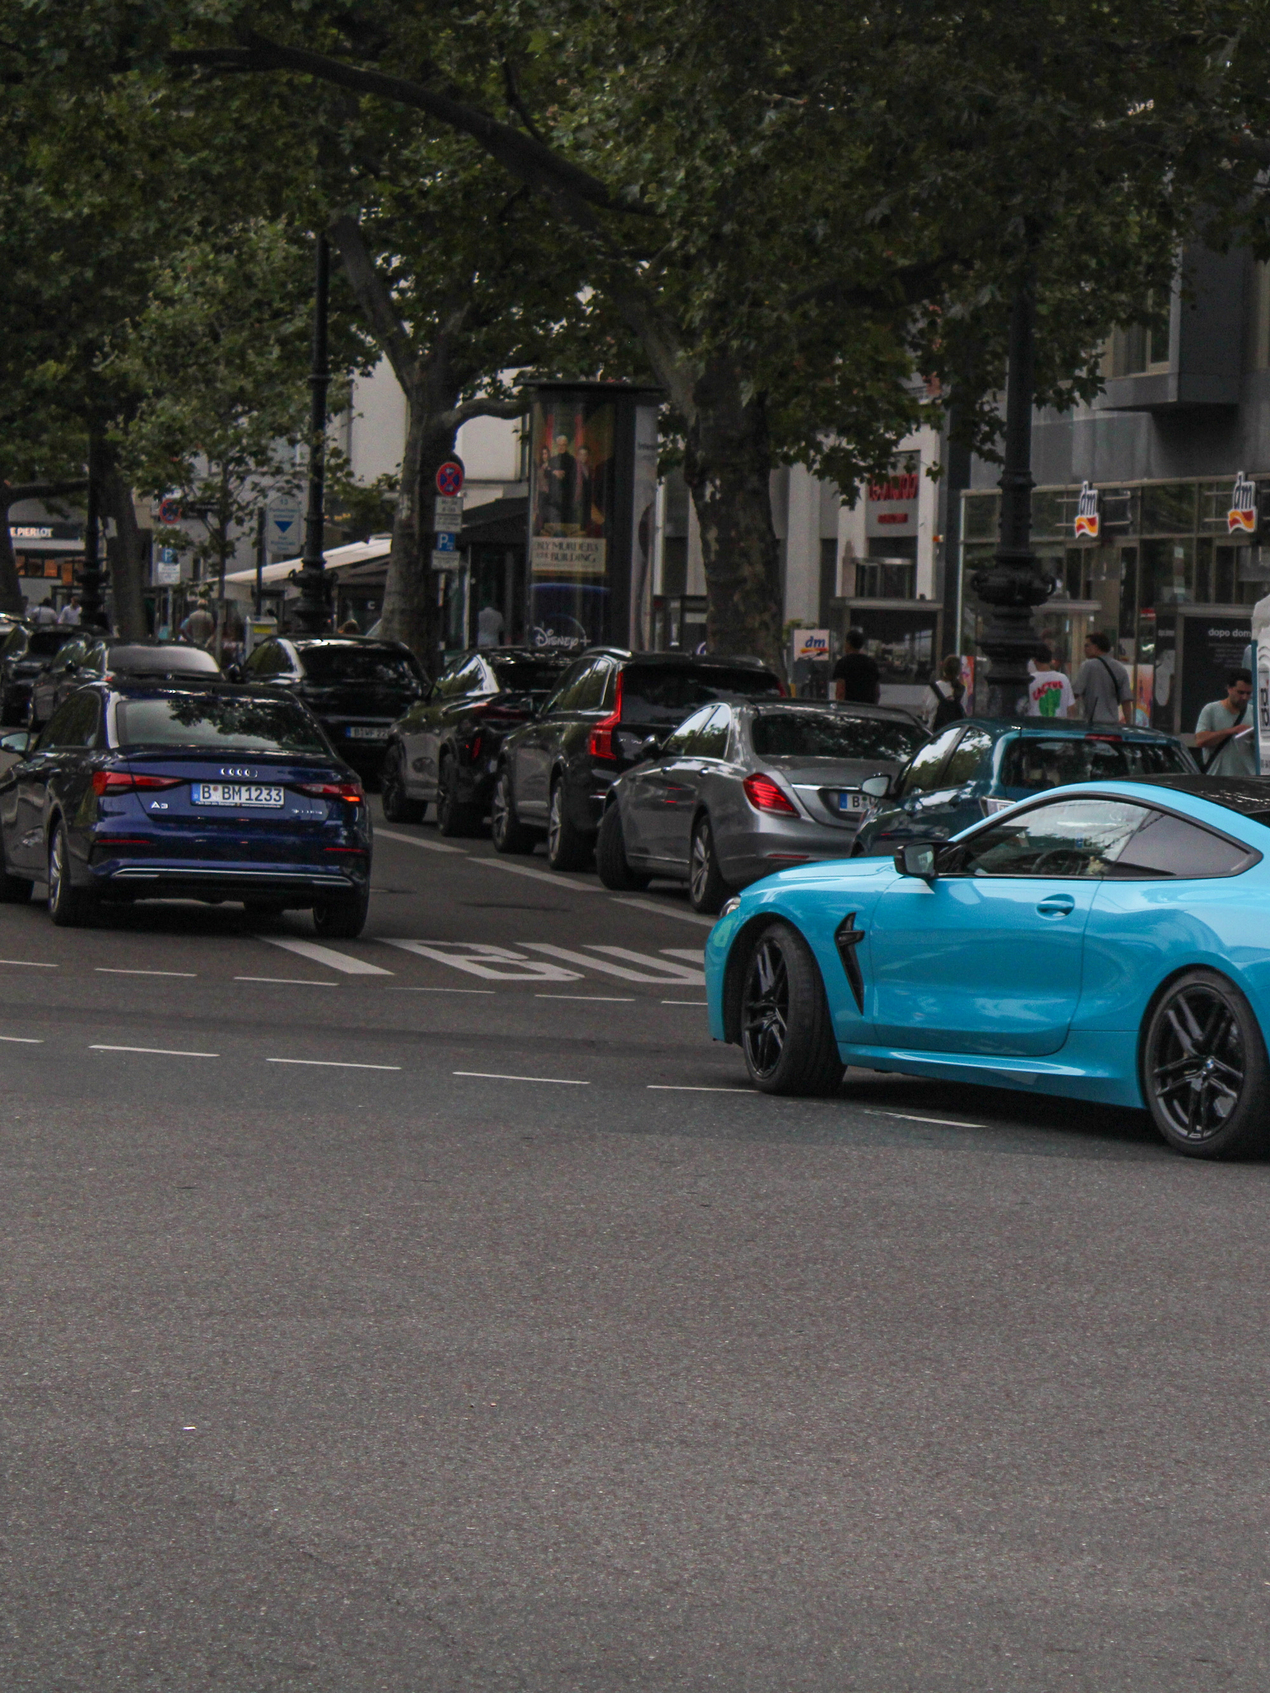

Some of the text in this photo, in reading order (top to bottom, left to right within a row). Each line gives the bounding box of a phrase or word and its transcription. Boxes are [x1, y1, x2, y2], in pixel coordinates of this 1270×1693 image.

[1080, 484, 1096, 516] dm
[1234, 475, 1252, 510] dm
[1208, 628, 1230, 638] dopo
[805, 636, 826, 648] dm
[1032, 680, 1064, 700] CACTUS
[150, 801, 168, 810] A3
[852, 796, 860, 808] B
[372, 937, 705, 986] BU
